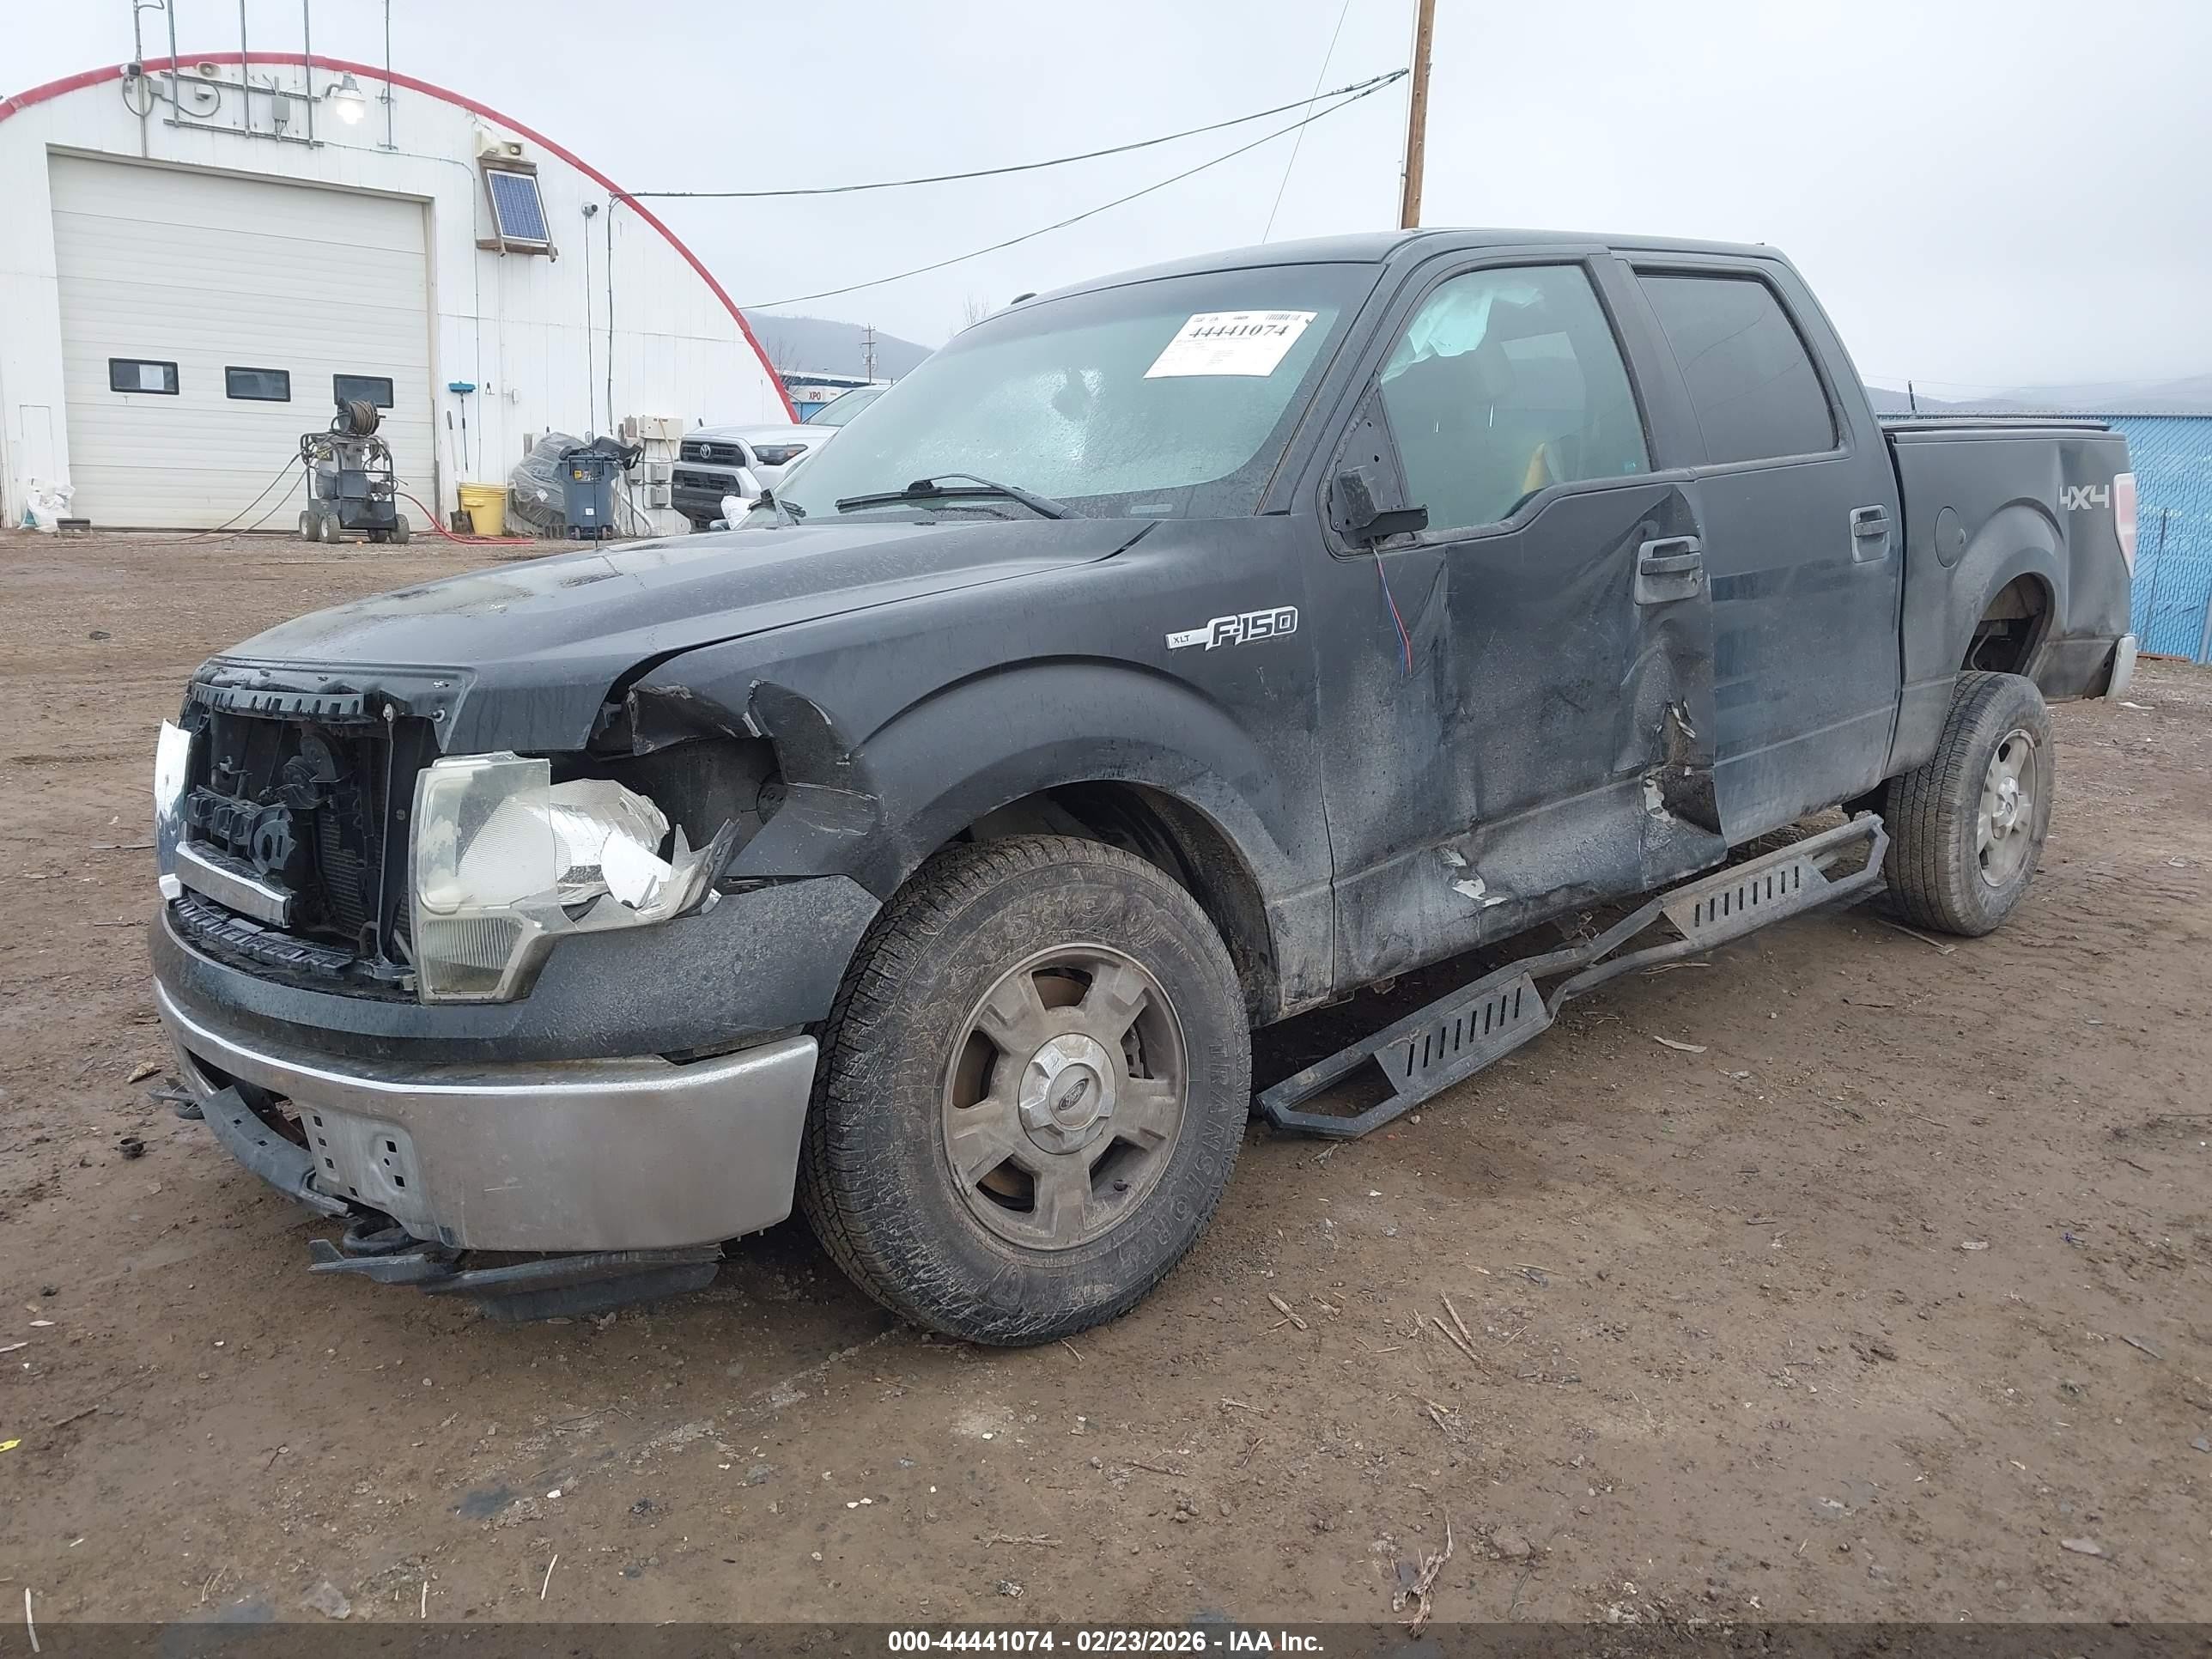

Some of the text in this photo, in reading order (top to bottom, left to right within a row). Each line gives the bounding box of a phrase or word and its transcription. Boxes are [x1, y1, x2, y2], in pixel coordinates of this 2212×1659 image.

[1189, 325, 1289, 338] 44441074
[808, 391, 822, 401] XPO
[1173, 605, 1298, 651] XLT F-150
